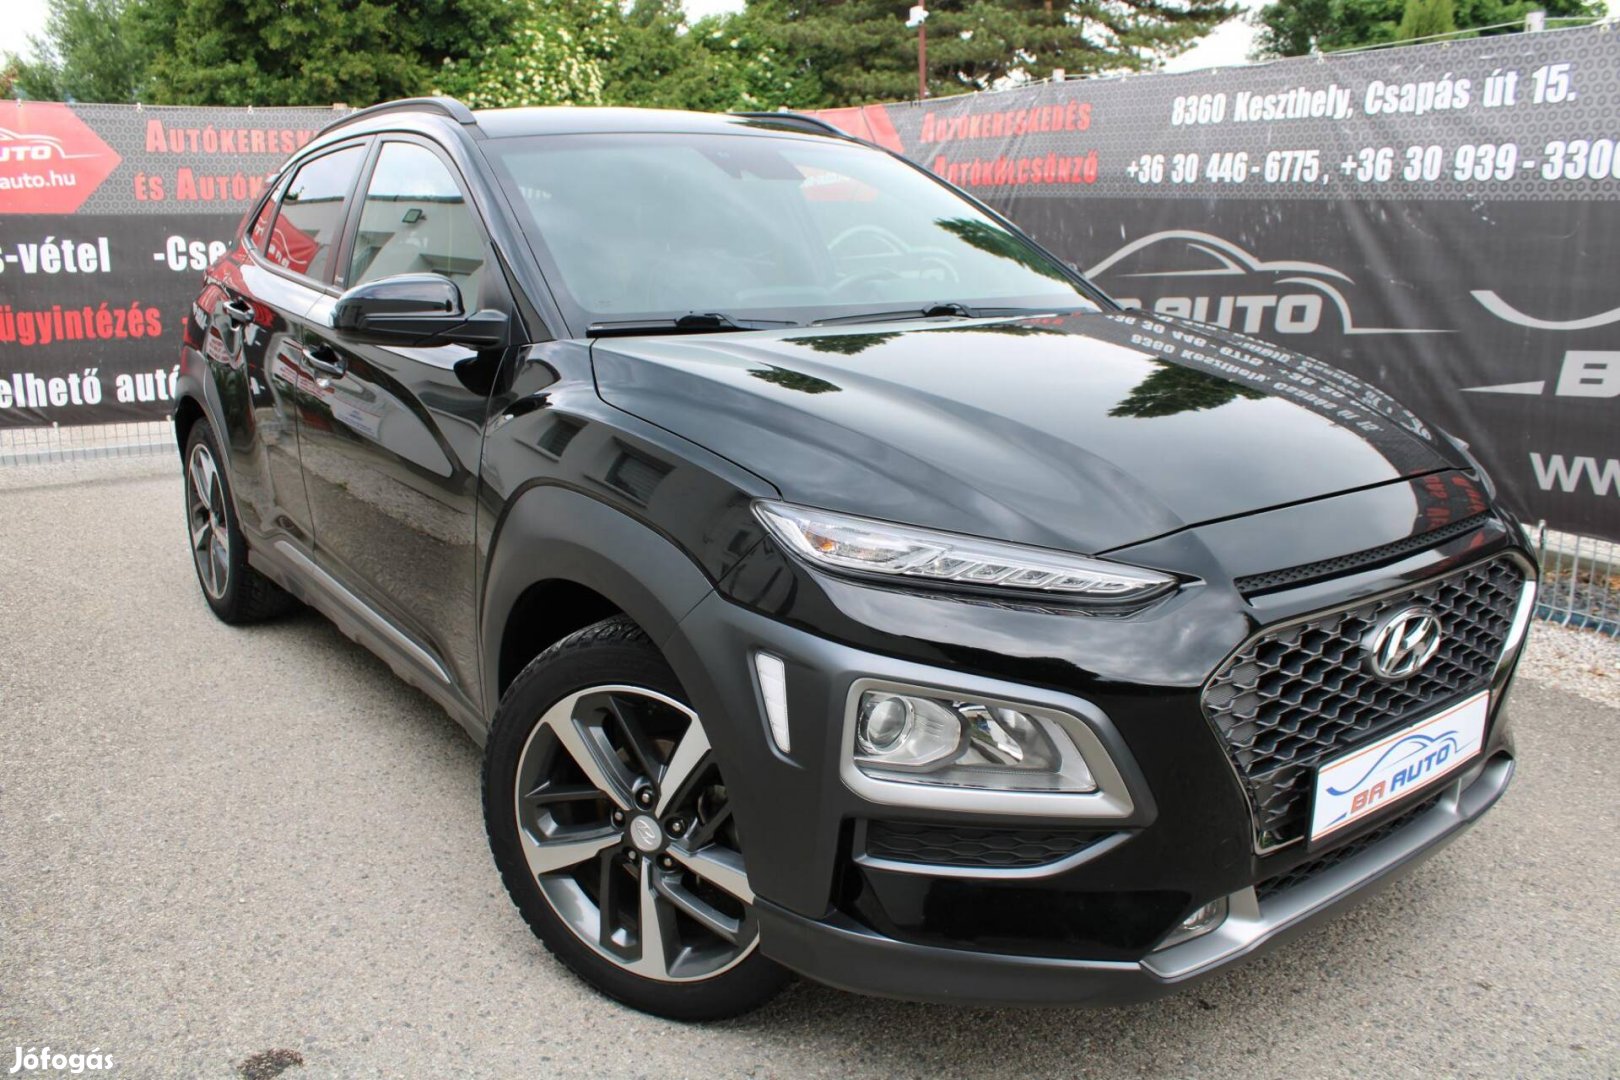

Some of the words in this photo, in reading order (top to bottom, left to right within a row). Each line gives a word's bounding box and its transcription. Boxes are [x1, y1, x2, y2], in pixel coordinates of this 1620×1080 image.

[1171, 93, 1226, 126] 8360
[1234, 84, 1354, 122] Keszthely,
[1364, 76, 1471, 116] Csapás
[1483, 69, 1518, 108] út
[1533, 63, 1577, 104] 15.
[145, 118, 319, 153] AUTÓKERESK
[176, 166, 275, 201] AUTÓK
[1126, 154, 1165, 184] +36
[1171, 153, 1199, 184] 30
[1340, 148, 1394, 183] +36
[1403, 145, 1443, 181] 30
[0, 235, 111, 274] -vétel
[153, 235, 233, 272] -Cse
[0, 368, 102, 408] elhető
[1350, 780, 1386, 814] BA
[1390, 743, 1451, 792] AUTO
